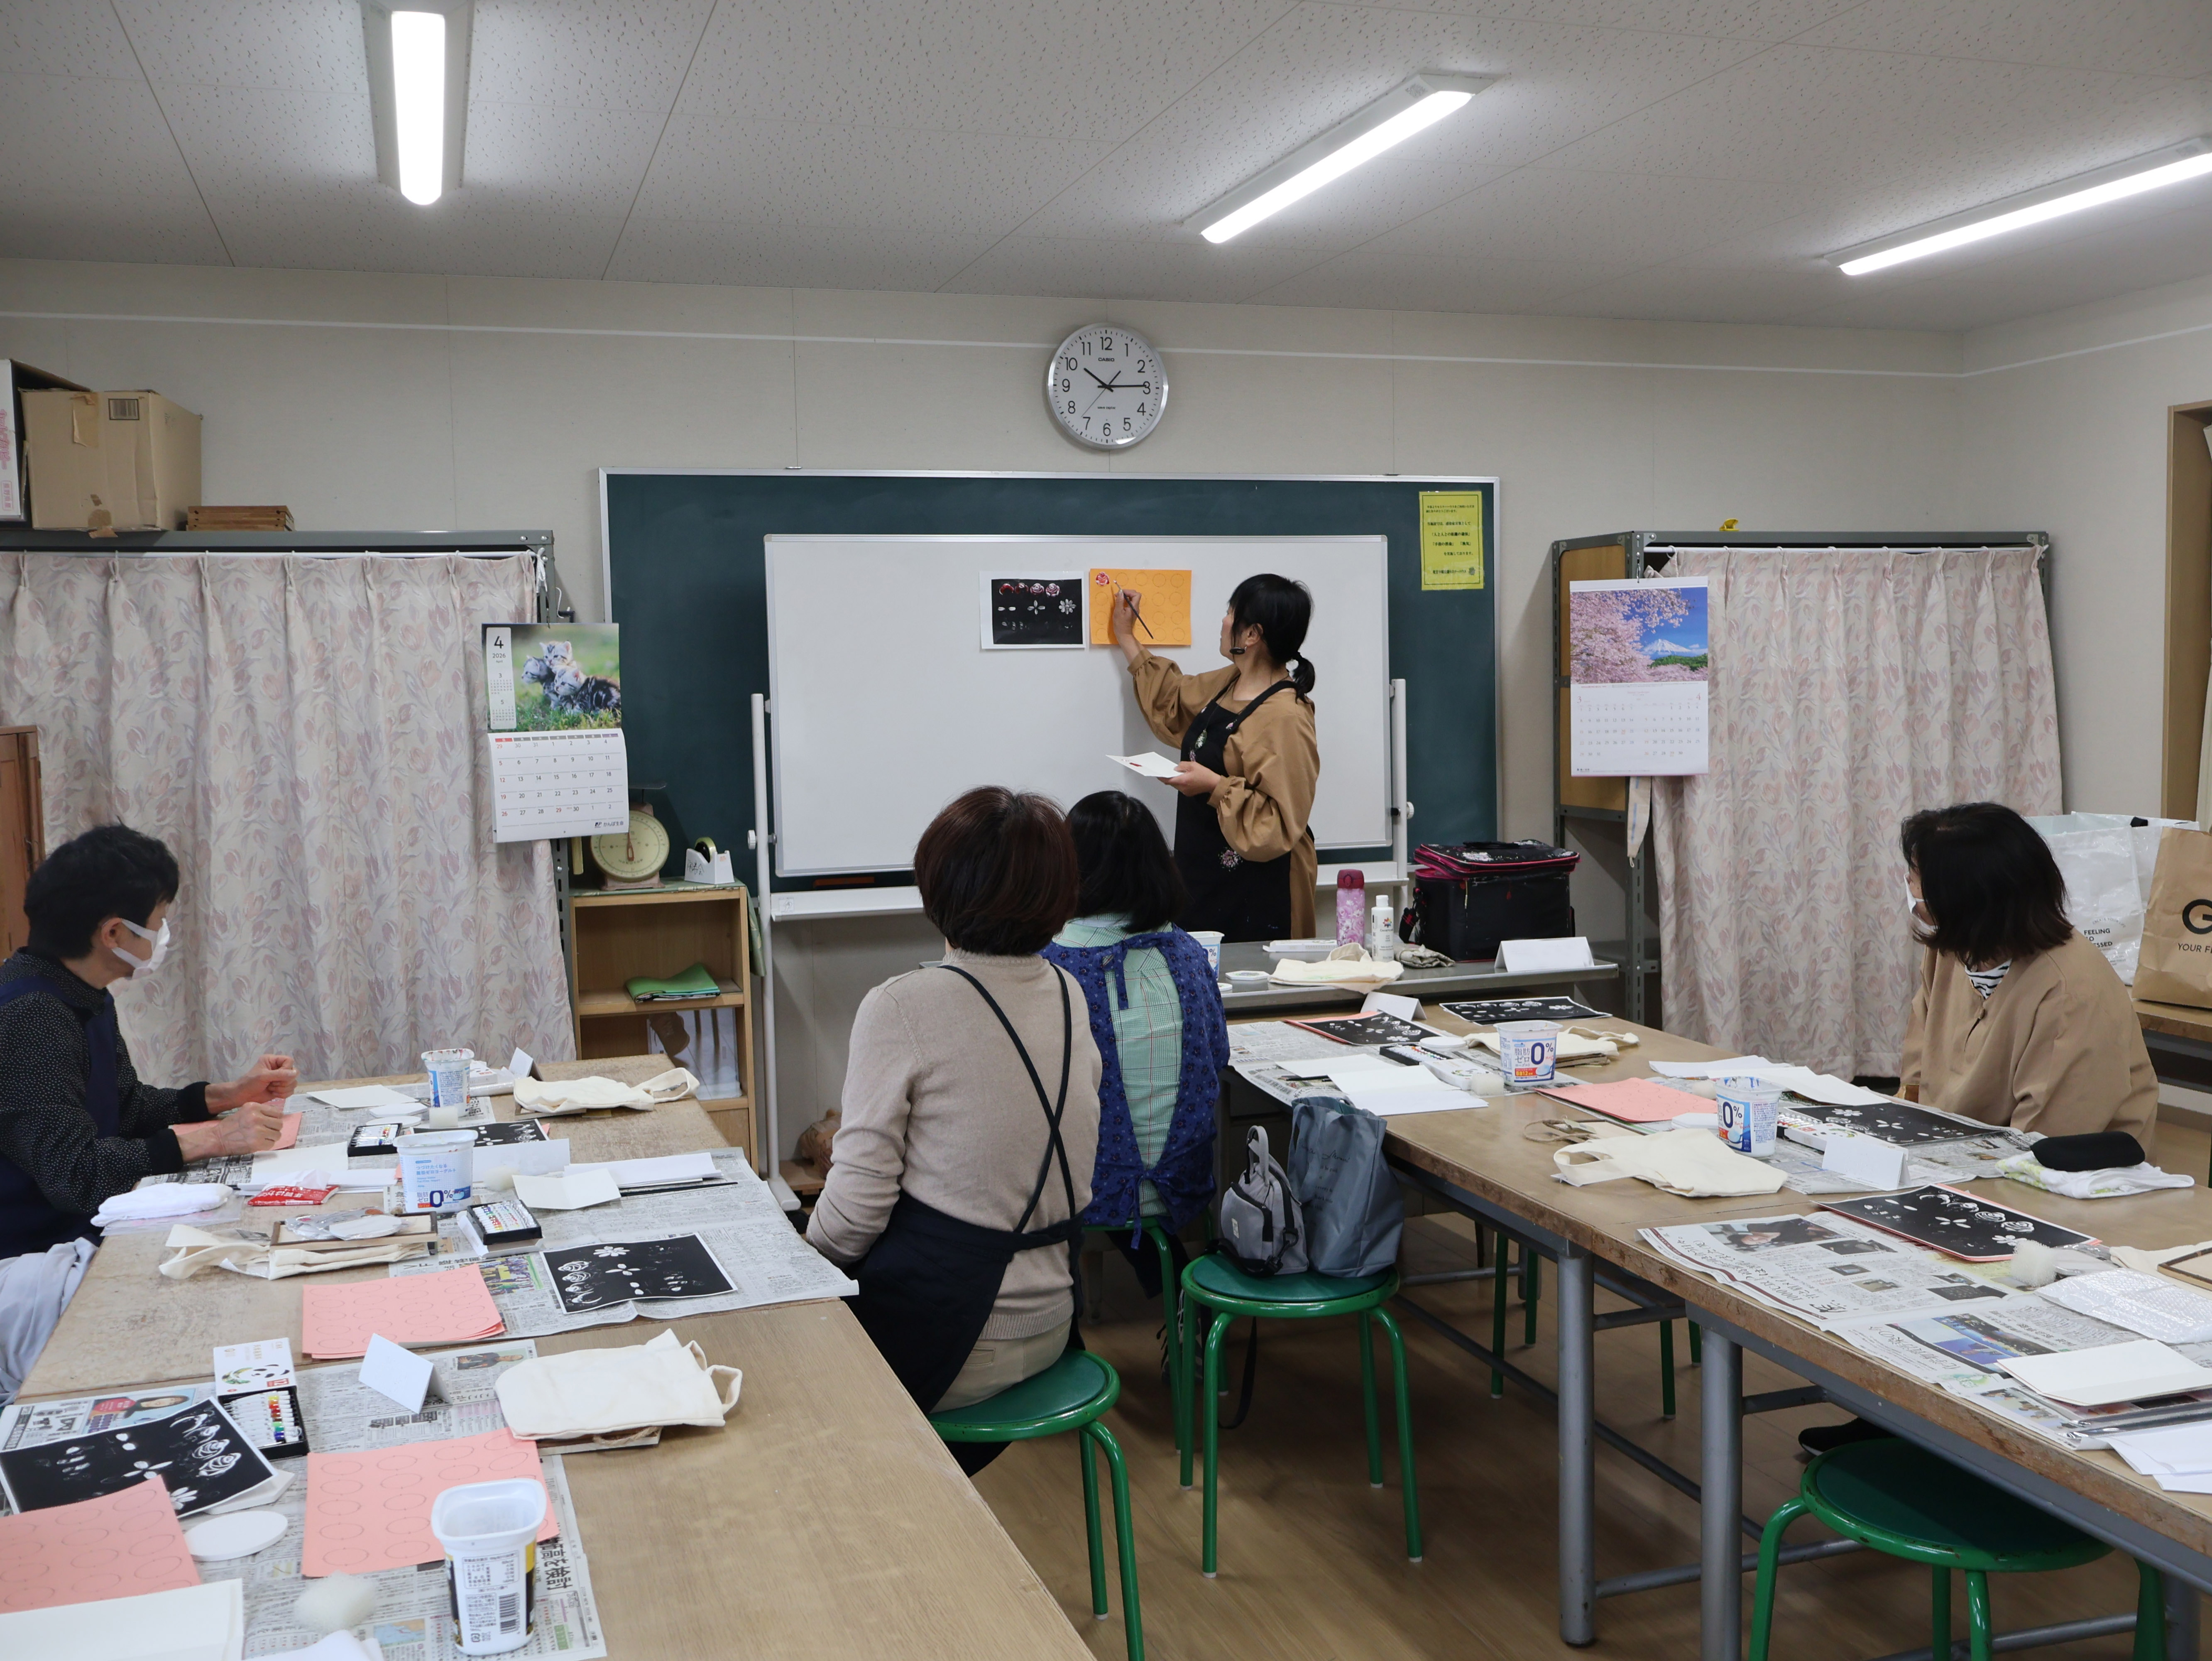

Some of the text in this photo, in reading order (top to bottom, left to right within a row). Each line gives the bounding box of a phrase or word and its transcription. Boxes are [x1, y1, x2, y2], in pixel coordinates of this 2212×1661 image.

[1082, 342, 1091, 355] 11
[1100, 337, 1112, 350] 12
[1125, 343, 1128, 357] 1
[1065, 357, 1077, 370] 10
[1138, 360, 1145, 373] 2
[1062, 379, 1070, 392] 9
[1143, 381, 1150, 394] 3
[1068, 401, 1075, 414] 8
[1137, 402, 1146, 416] 4
[1083, 417, 1091, 430] 7
[1103, 423, 1111, 436] 6
[1123, 418, 1131, 431] 5
[494, 636, 504, 649] 4
[2178, 943, 2202, 952] YOUR
